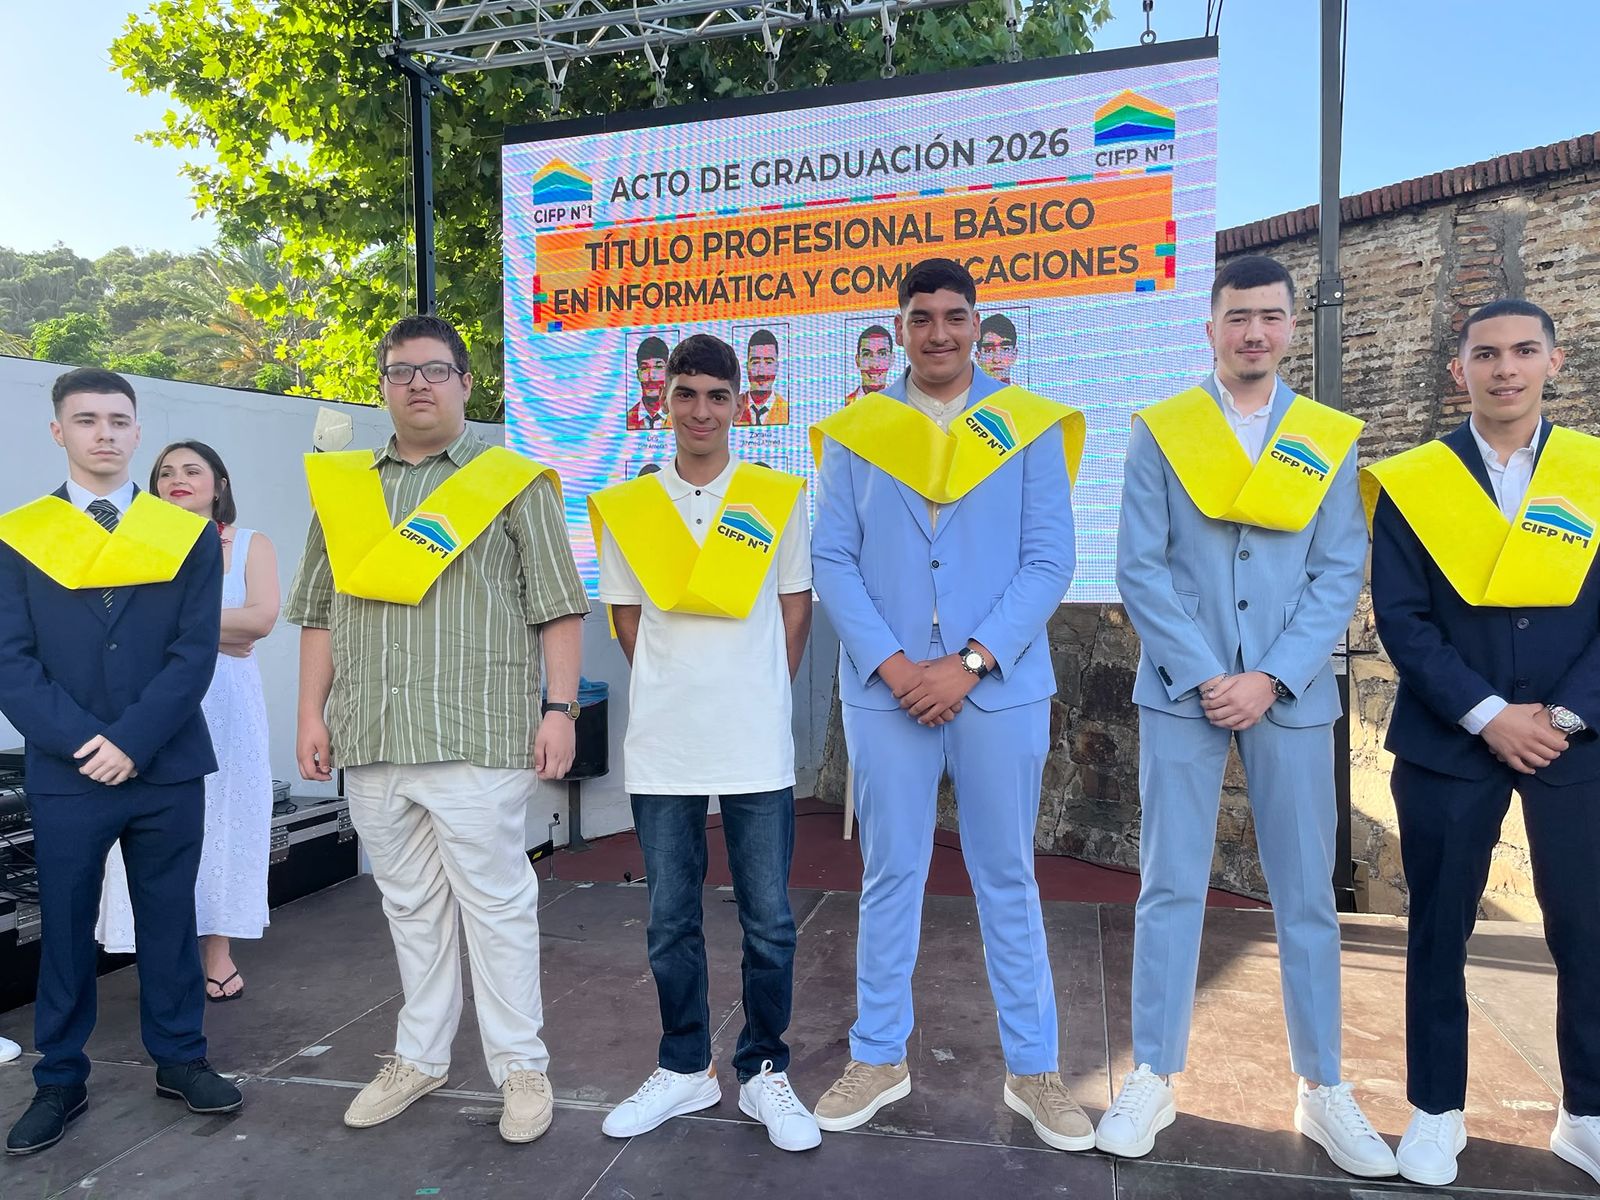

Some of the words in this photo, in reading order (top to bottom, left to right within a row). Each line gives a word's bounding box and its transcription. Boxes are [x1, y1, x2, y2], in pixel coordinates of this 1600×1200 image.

[610, 170, 690, 203] ACTO
[701, 164, 741, 194] DE
[751, 133, 975, 188] GRADUACIÓN
[987, 127, 1070, 164] 2026
[1095, 149, 1138, 167] CIFP
[533, 207, 566, 224] CIFP
[585, 233, 693, 271] TÍTULO
[703, 211, 943, 262] PROFESIONAL
[954, 197, 1095, 240] BÁSICO
[554, 287, 589, 315] EN
[598, 270, 796, 312] INFORMÁTICA
[802, 269, 823, 296] Y
[830, 243, 1139, 296] COMCACIONES
[966, 417, 988, 438] CIFP
[1271, 450, 1300, 467] CIFP
[400, 529, 427, 545] CIFP
[717, 525, 745, 542] CIFP
[1521, 521, 1558, 537] CIFP
